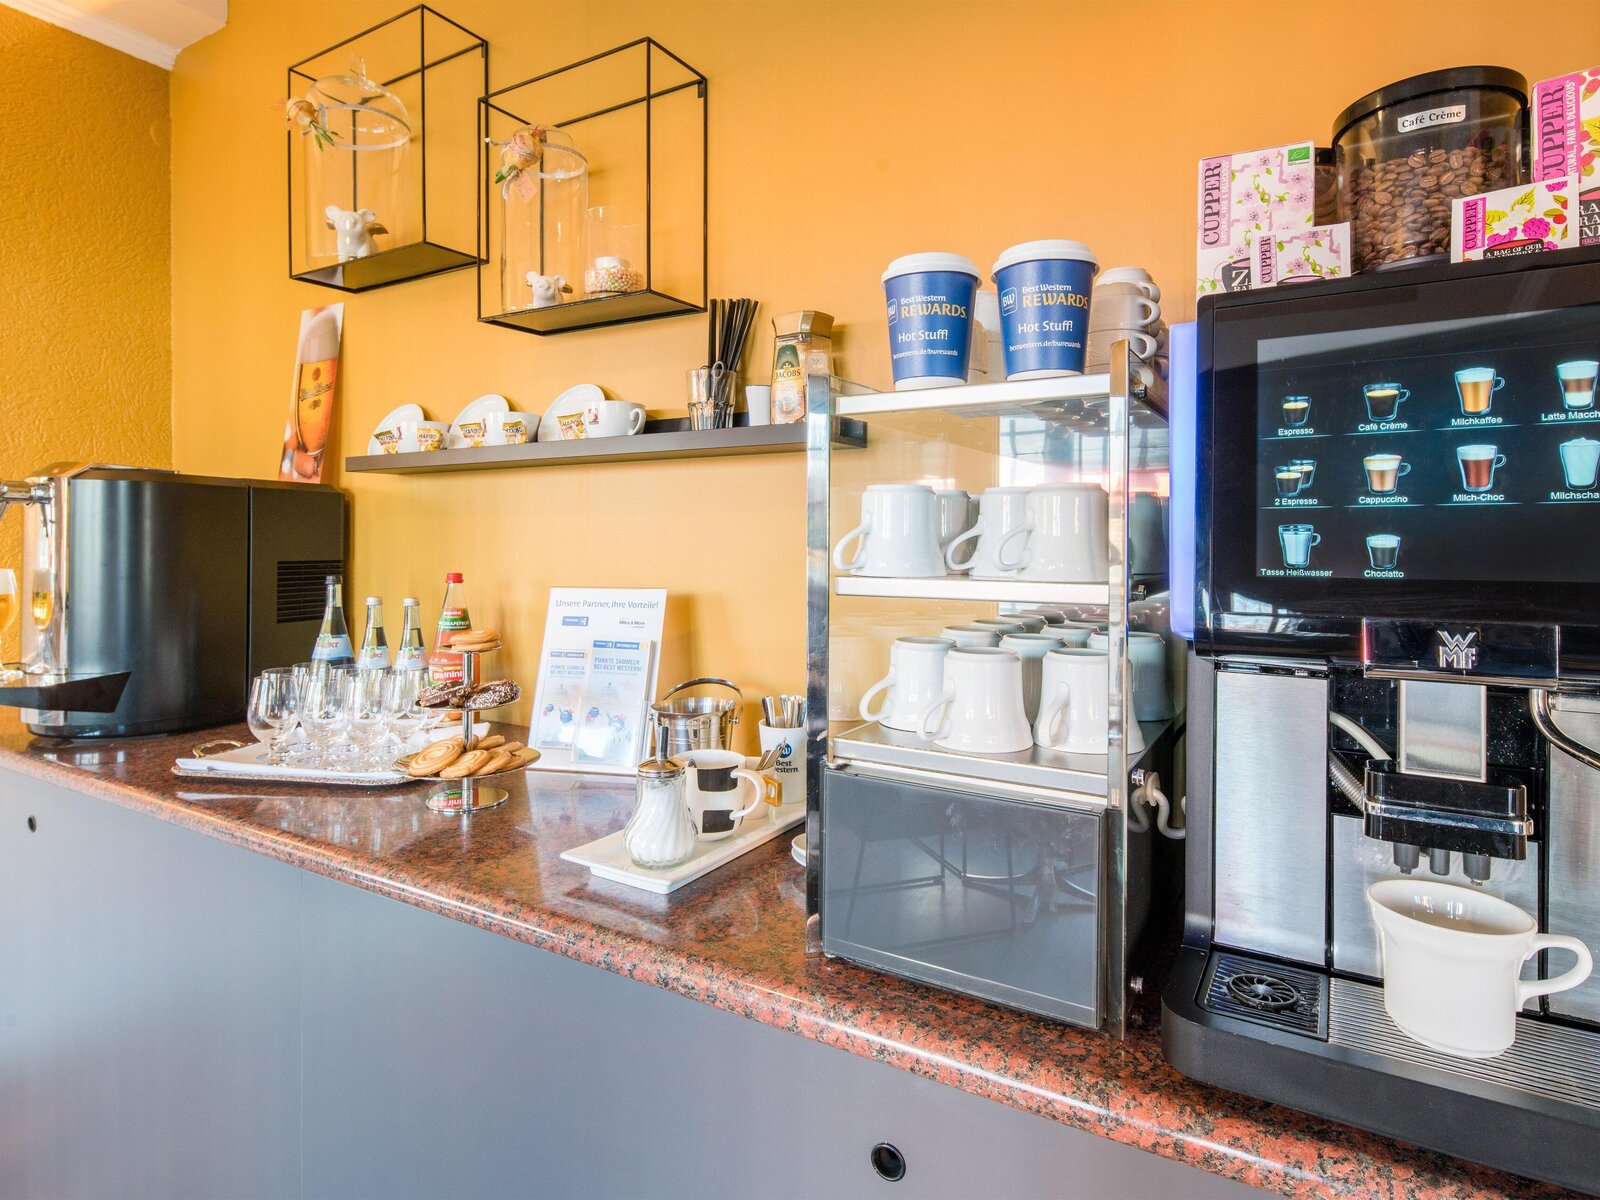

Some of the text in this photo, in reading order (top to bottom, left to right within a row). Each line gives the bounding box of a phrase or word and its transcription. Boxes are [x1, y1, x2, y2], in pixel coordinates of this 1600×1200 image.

[1402, 109, 1462, 128] Café Crème
[1541, 85, 1565, 181] CUPPER
[1567, 128, 1576, 145] FAIR
[1567, 145, 1577, 175] ATURAL,
[1203, 162, 1221, 246] CUPPER
[1465, 202, 1477, 249] CUPPER
[1494, 247, 1511, 256] BAG
[1524, 243, 1542, 251] OUR
[1260, 237, 1272, 284] CUPPER
[1022, 285, 1039, 293] Best
[901, 296, 915, 304] Best
[1002, 292, 1088, 309] BW REWARDS
[901, 303, 966, 318] REWARDS
[1018, 320, 1073, 334] Hot Stuff!
[898, 329, 948, 343] Hot Stuff!
[775, 369, 801, 380] JACOBS
[1451, 415, 1503, 426] Milchkaffee
[1541, 412, 1566, 421] Latte
[1278, 427, 1314, 437] Espresso
[1358, 420, 1408, 432] Café Crème
[1358, 495, 1408, 506] Cappuccino
[1453, 493, 1505, 502] Milch-Choc
[1550, 491, 1600, 500] Milchscha
[1282, 497, 1318, 507] Espresso
[1260, 567, 1333, 577] Tasse Heißwasser
[1364, 569, 1404, 578] Chociatto
[555, 600, 659, 609] Unsere Partner, Ihre Vorteile!
[1437, 630, 1476, 669] WMF
